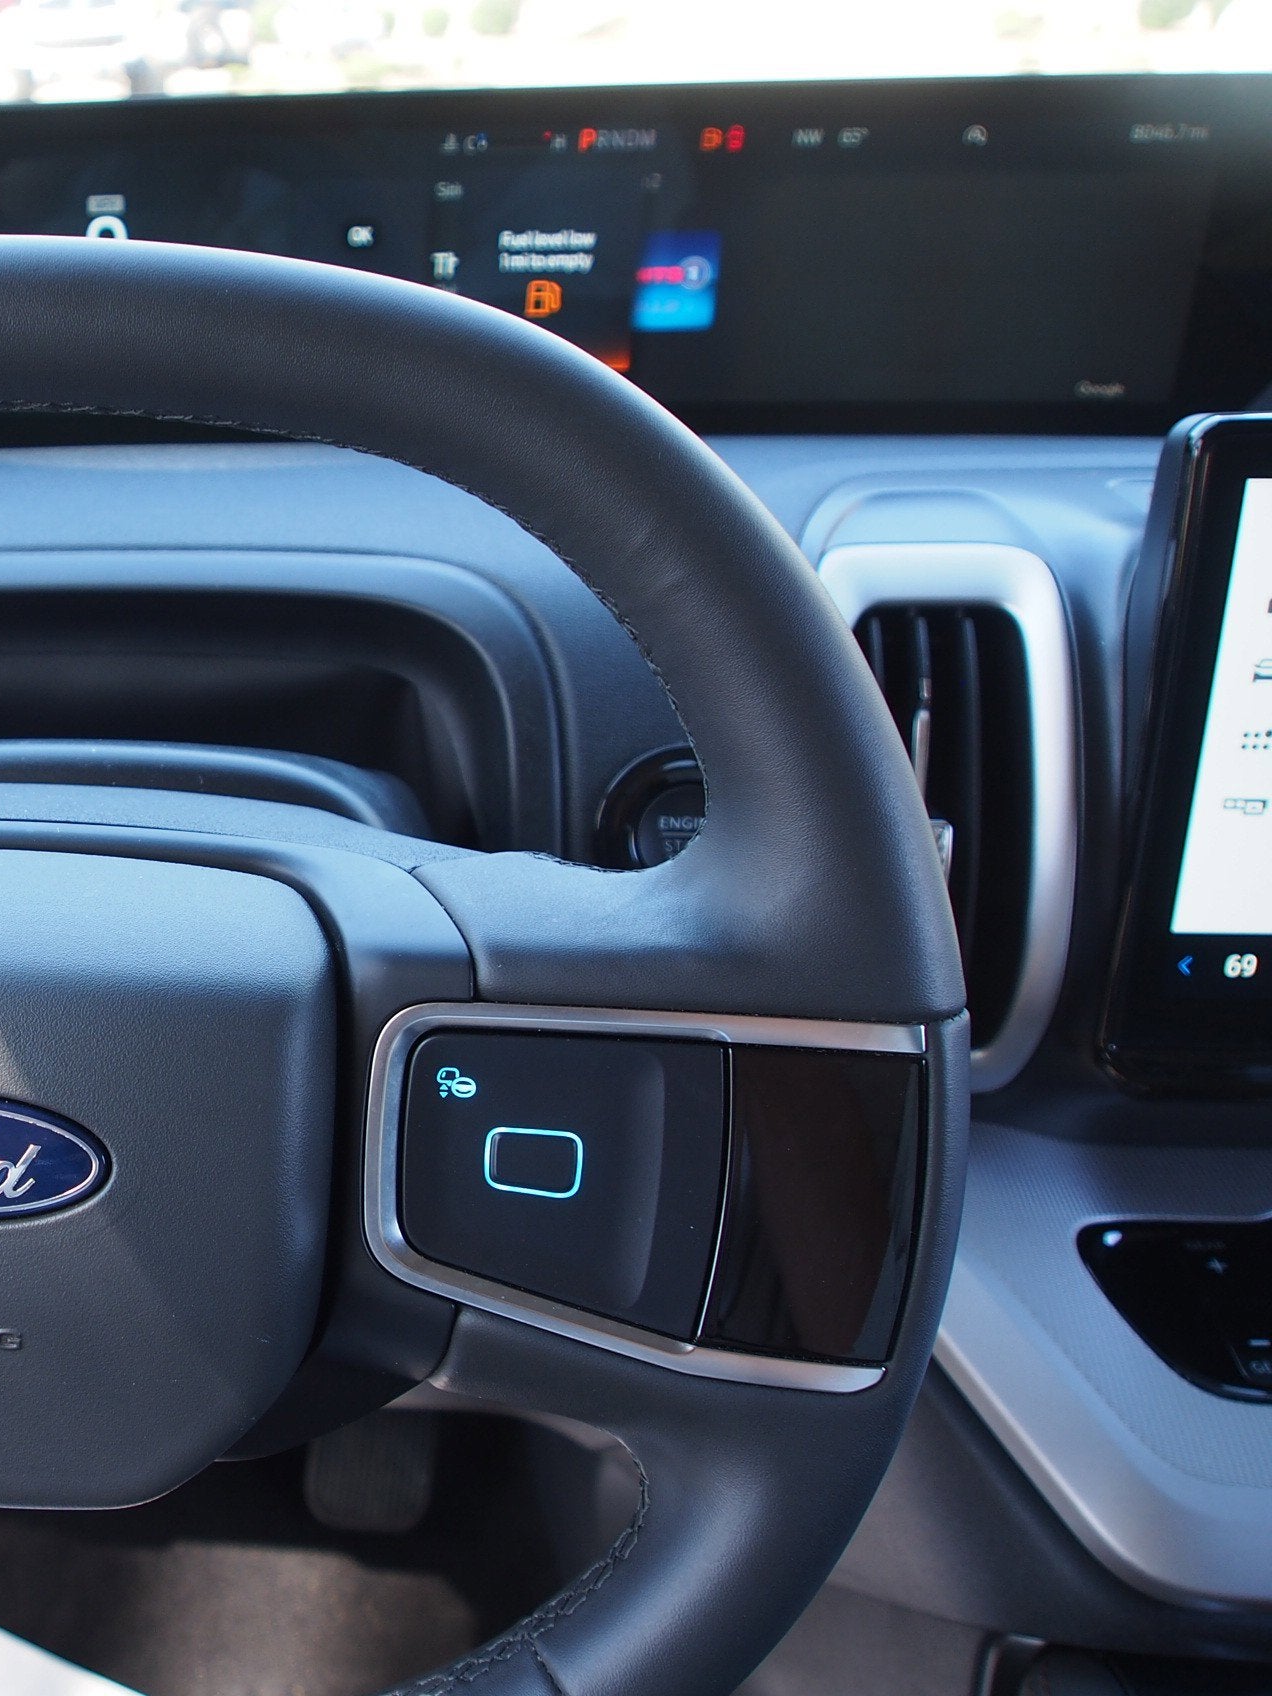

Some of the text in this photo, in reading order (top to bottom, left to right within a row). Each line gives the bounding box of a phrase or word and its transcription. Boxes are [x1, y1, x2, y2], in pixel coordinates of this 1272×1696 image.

[499, 230, 596, 250] Fuel level low
[547, 252, 593, 274] empty
[659, 815, 702, 830] ENGI
[1224, 953, 1258, 978] 69
